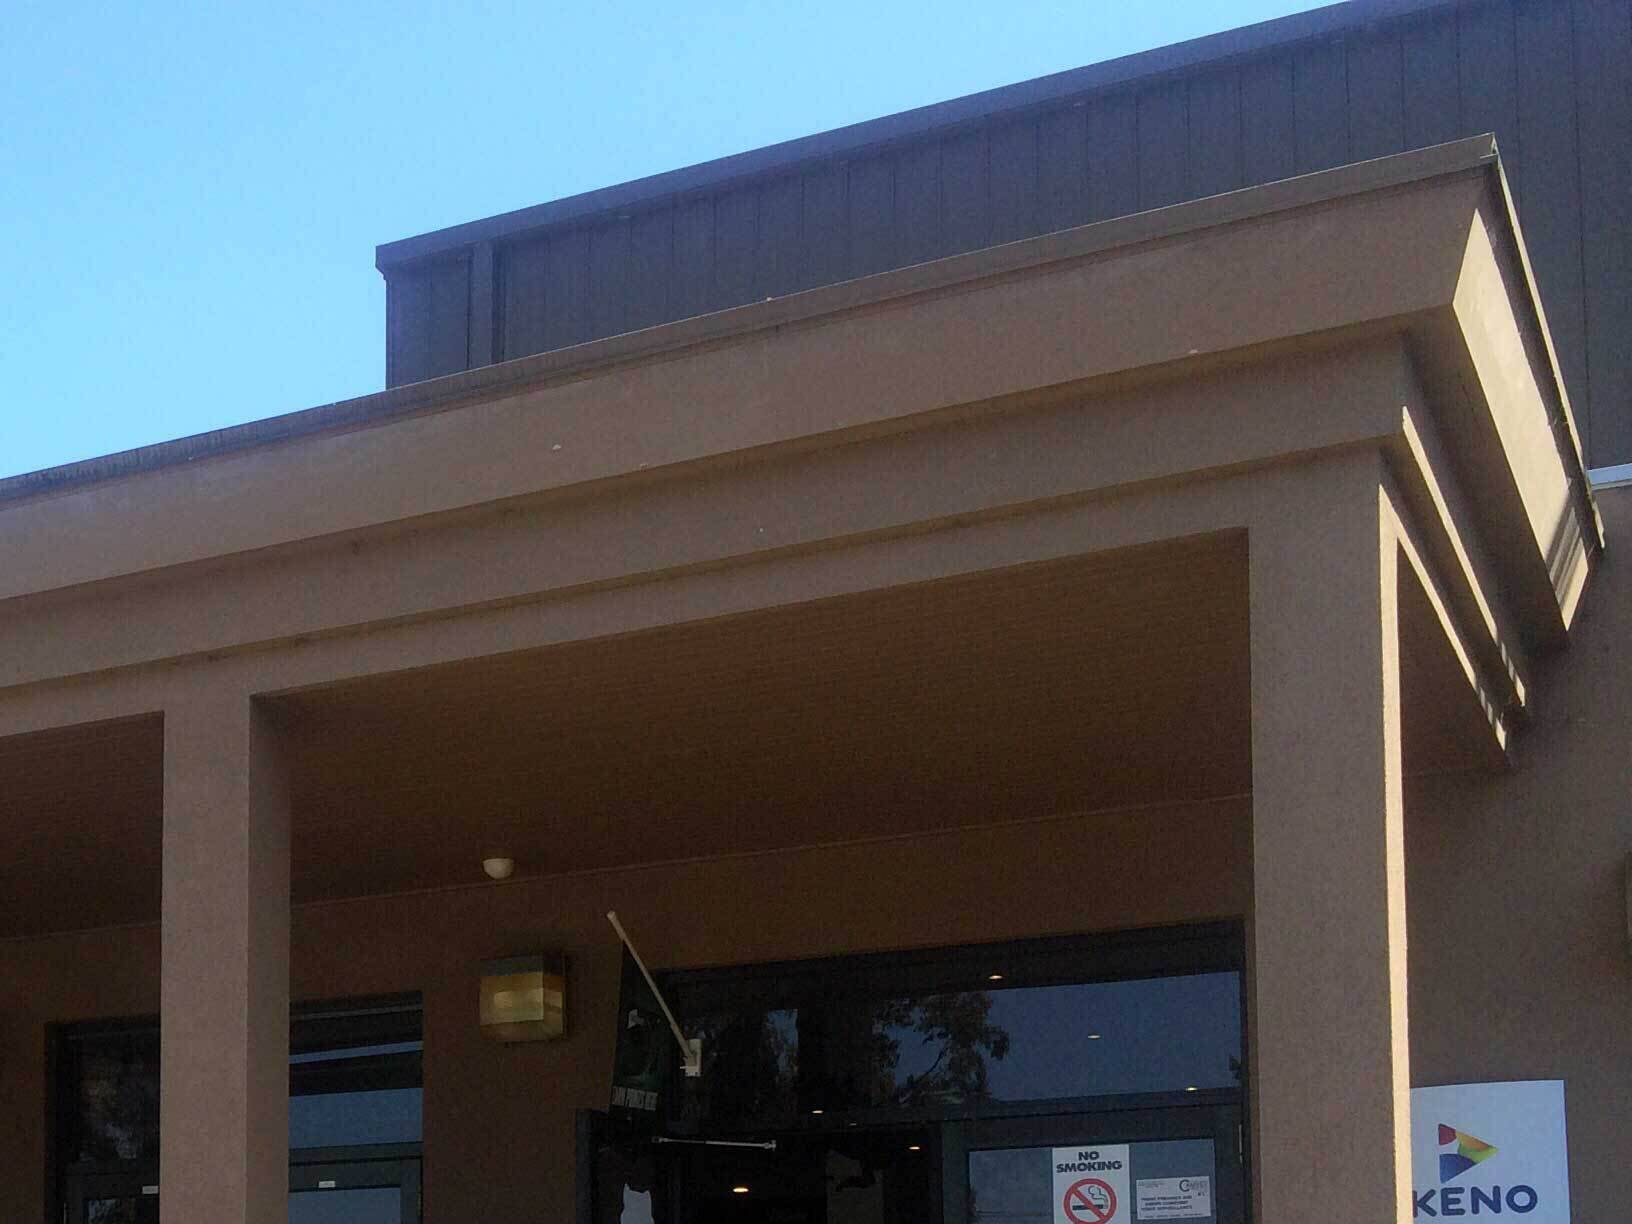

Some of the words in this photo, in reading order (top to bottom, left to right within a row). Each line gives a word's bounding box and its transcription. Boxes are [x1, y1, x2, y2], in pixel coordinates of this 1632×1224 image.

[1078, 1151, 1100, 1162] NO
[1056, 1160, 1123, 1173] SMOKING
[1413, 1184, 1538, 1218] KENO
